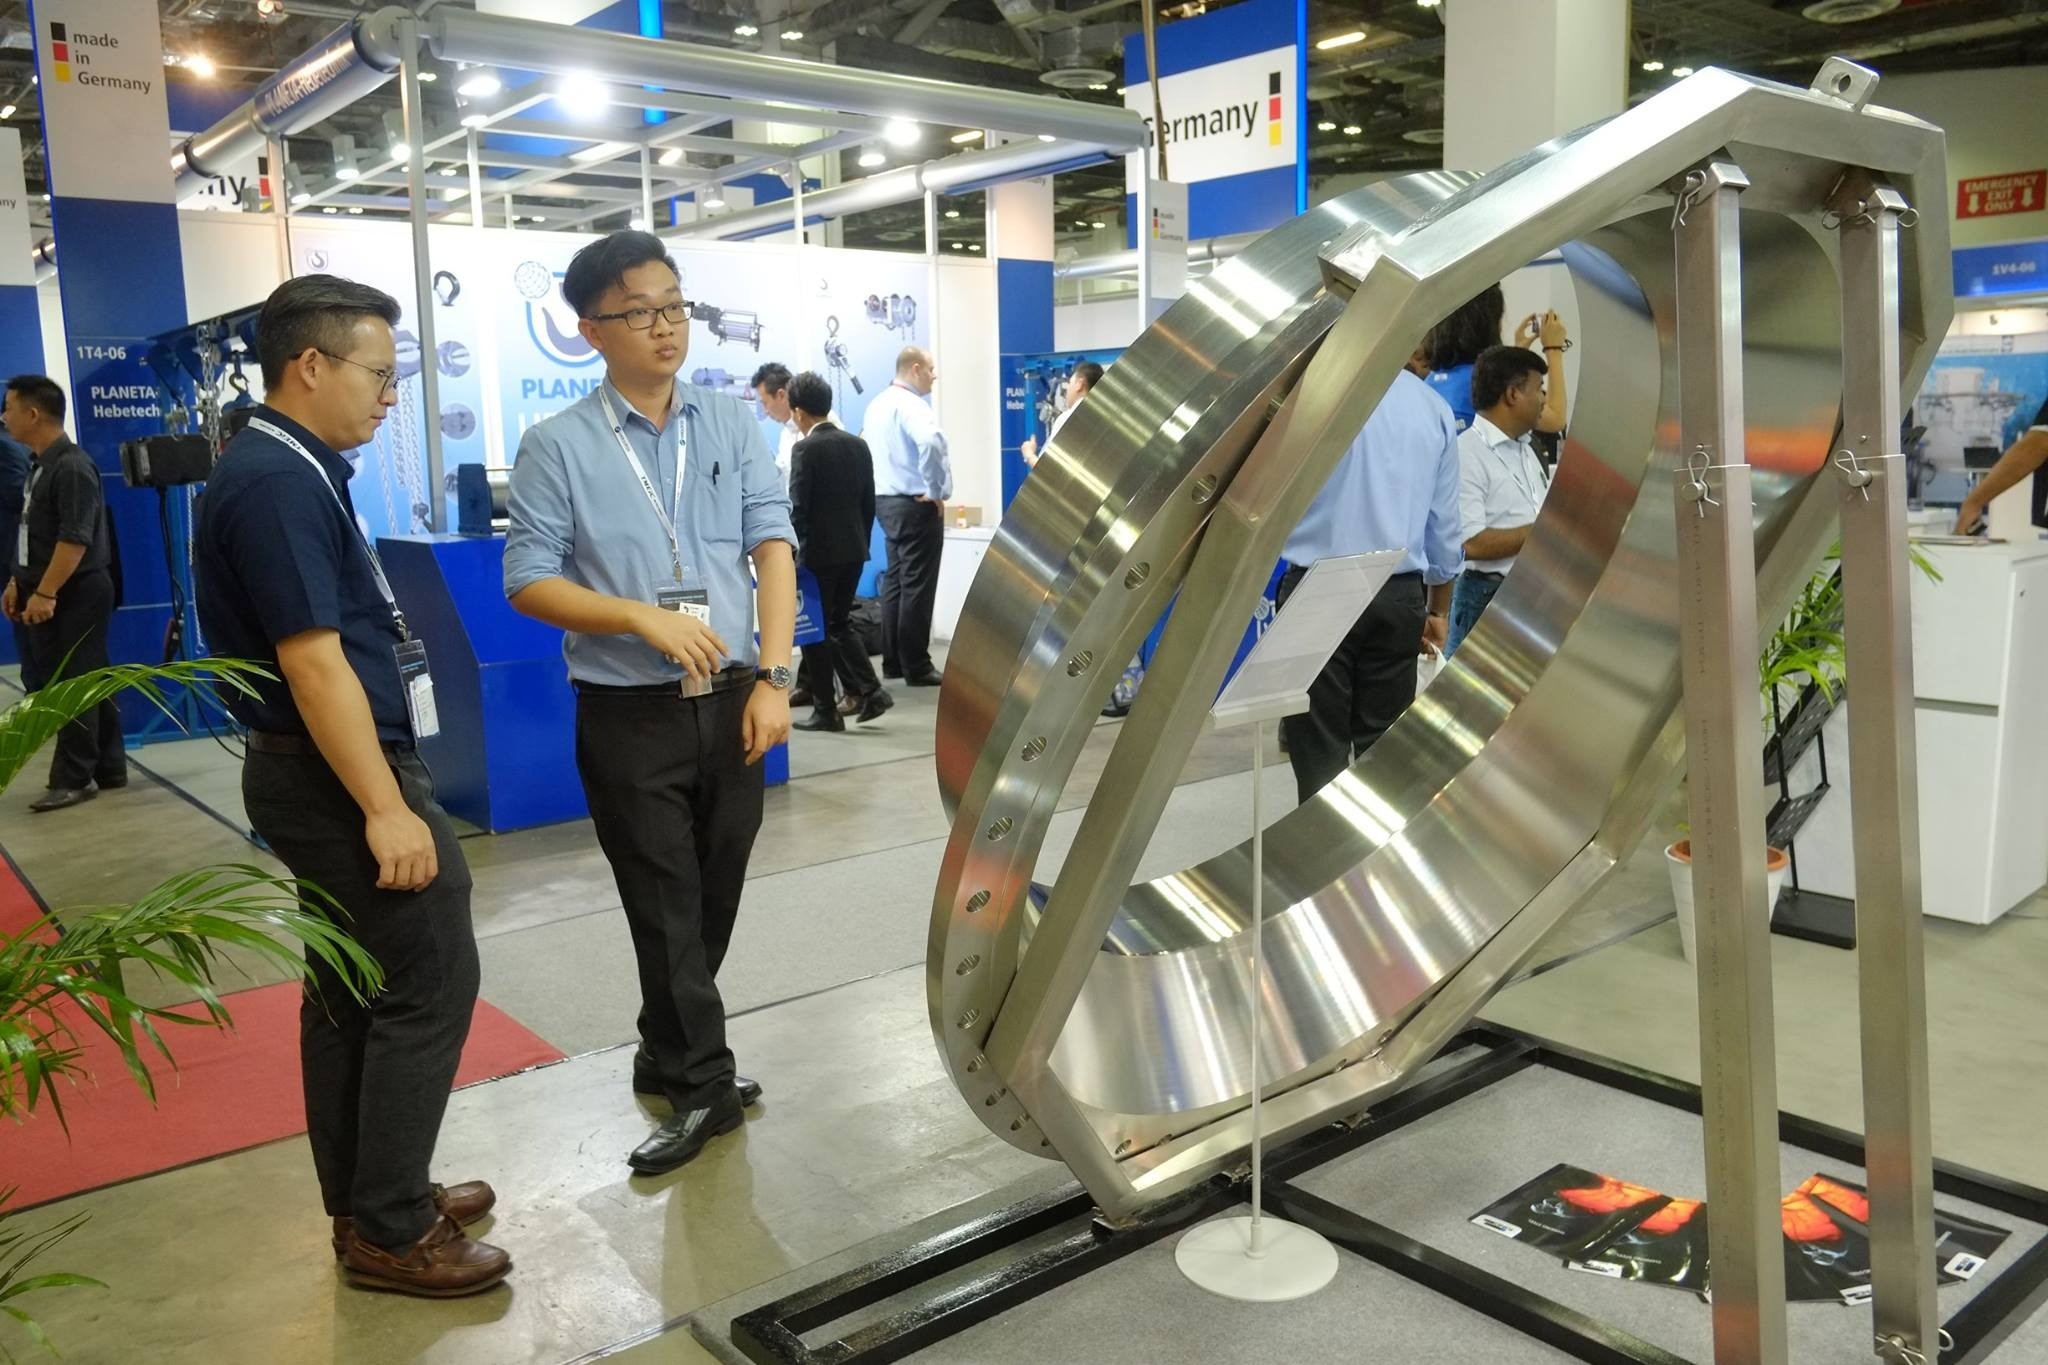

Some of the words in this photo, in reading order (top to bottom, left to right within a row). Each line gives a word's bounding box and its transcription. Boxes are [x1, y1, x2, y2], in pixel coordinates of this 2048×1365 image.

[73, 33, 119, 48] made
[75, 50, 90, 65] in
[78, 71, 151, 95] Germany
[1965, 175, 2038, 193] EMERGENCY
[1988, 189, 2012, 201] EXIT
[1984, 200, 2016, 213] ONLY
[77, 346, 126, 360] 1T4-06
